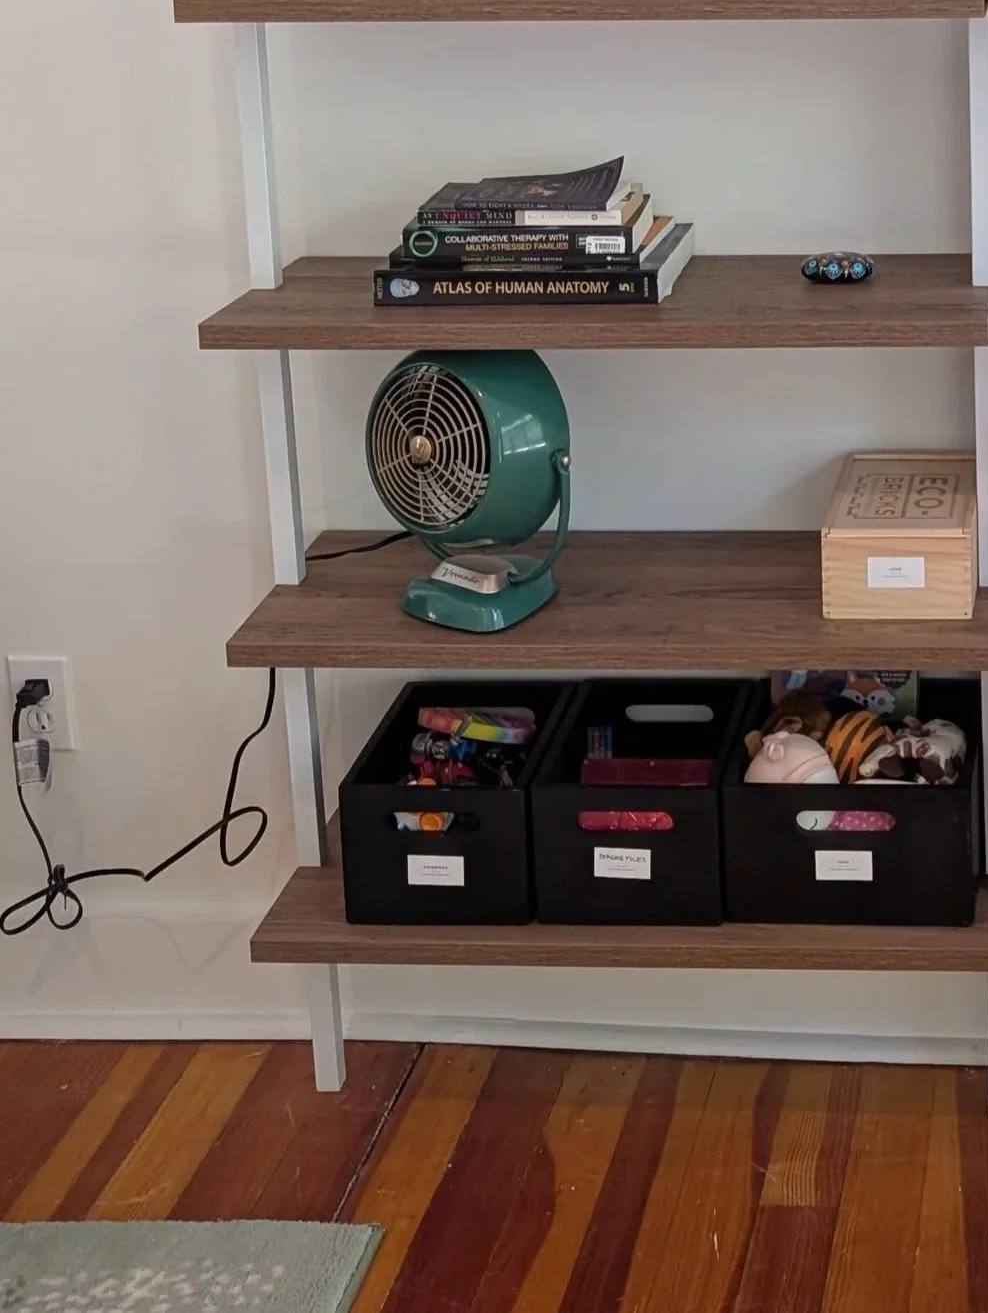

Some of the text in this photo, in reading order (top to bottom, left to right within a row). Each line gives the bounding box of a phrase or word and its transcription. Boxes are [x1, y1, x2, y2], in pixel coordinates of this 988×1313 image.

[444, 234, 509, 244] COLLABORATIVE
[511, 234, 547, 243] THERAPY
[549, 234, 569, 242] WITH
[465, 242, 532, 252] MULTI-STRESSED
[533, 242, 569, 250] FAMILIES
[432, 281, 609, 295] ATLAS OF HUMAN ANATOMY
[874, 475, 906, 517] BRICKS
[914, 477, 949, 509] ECO
